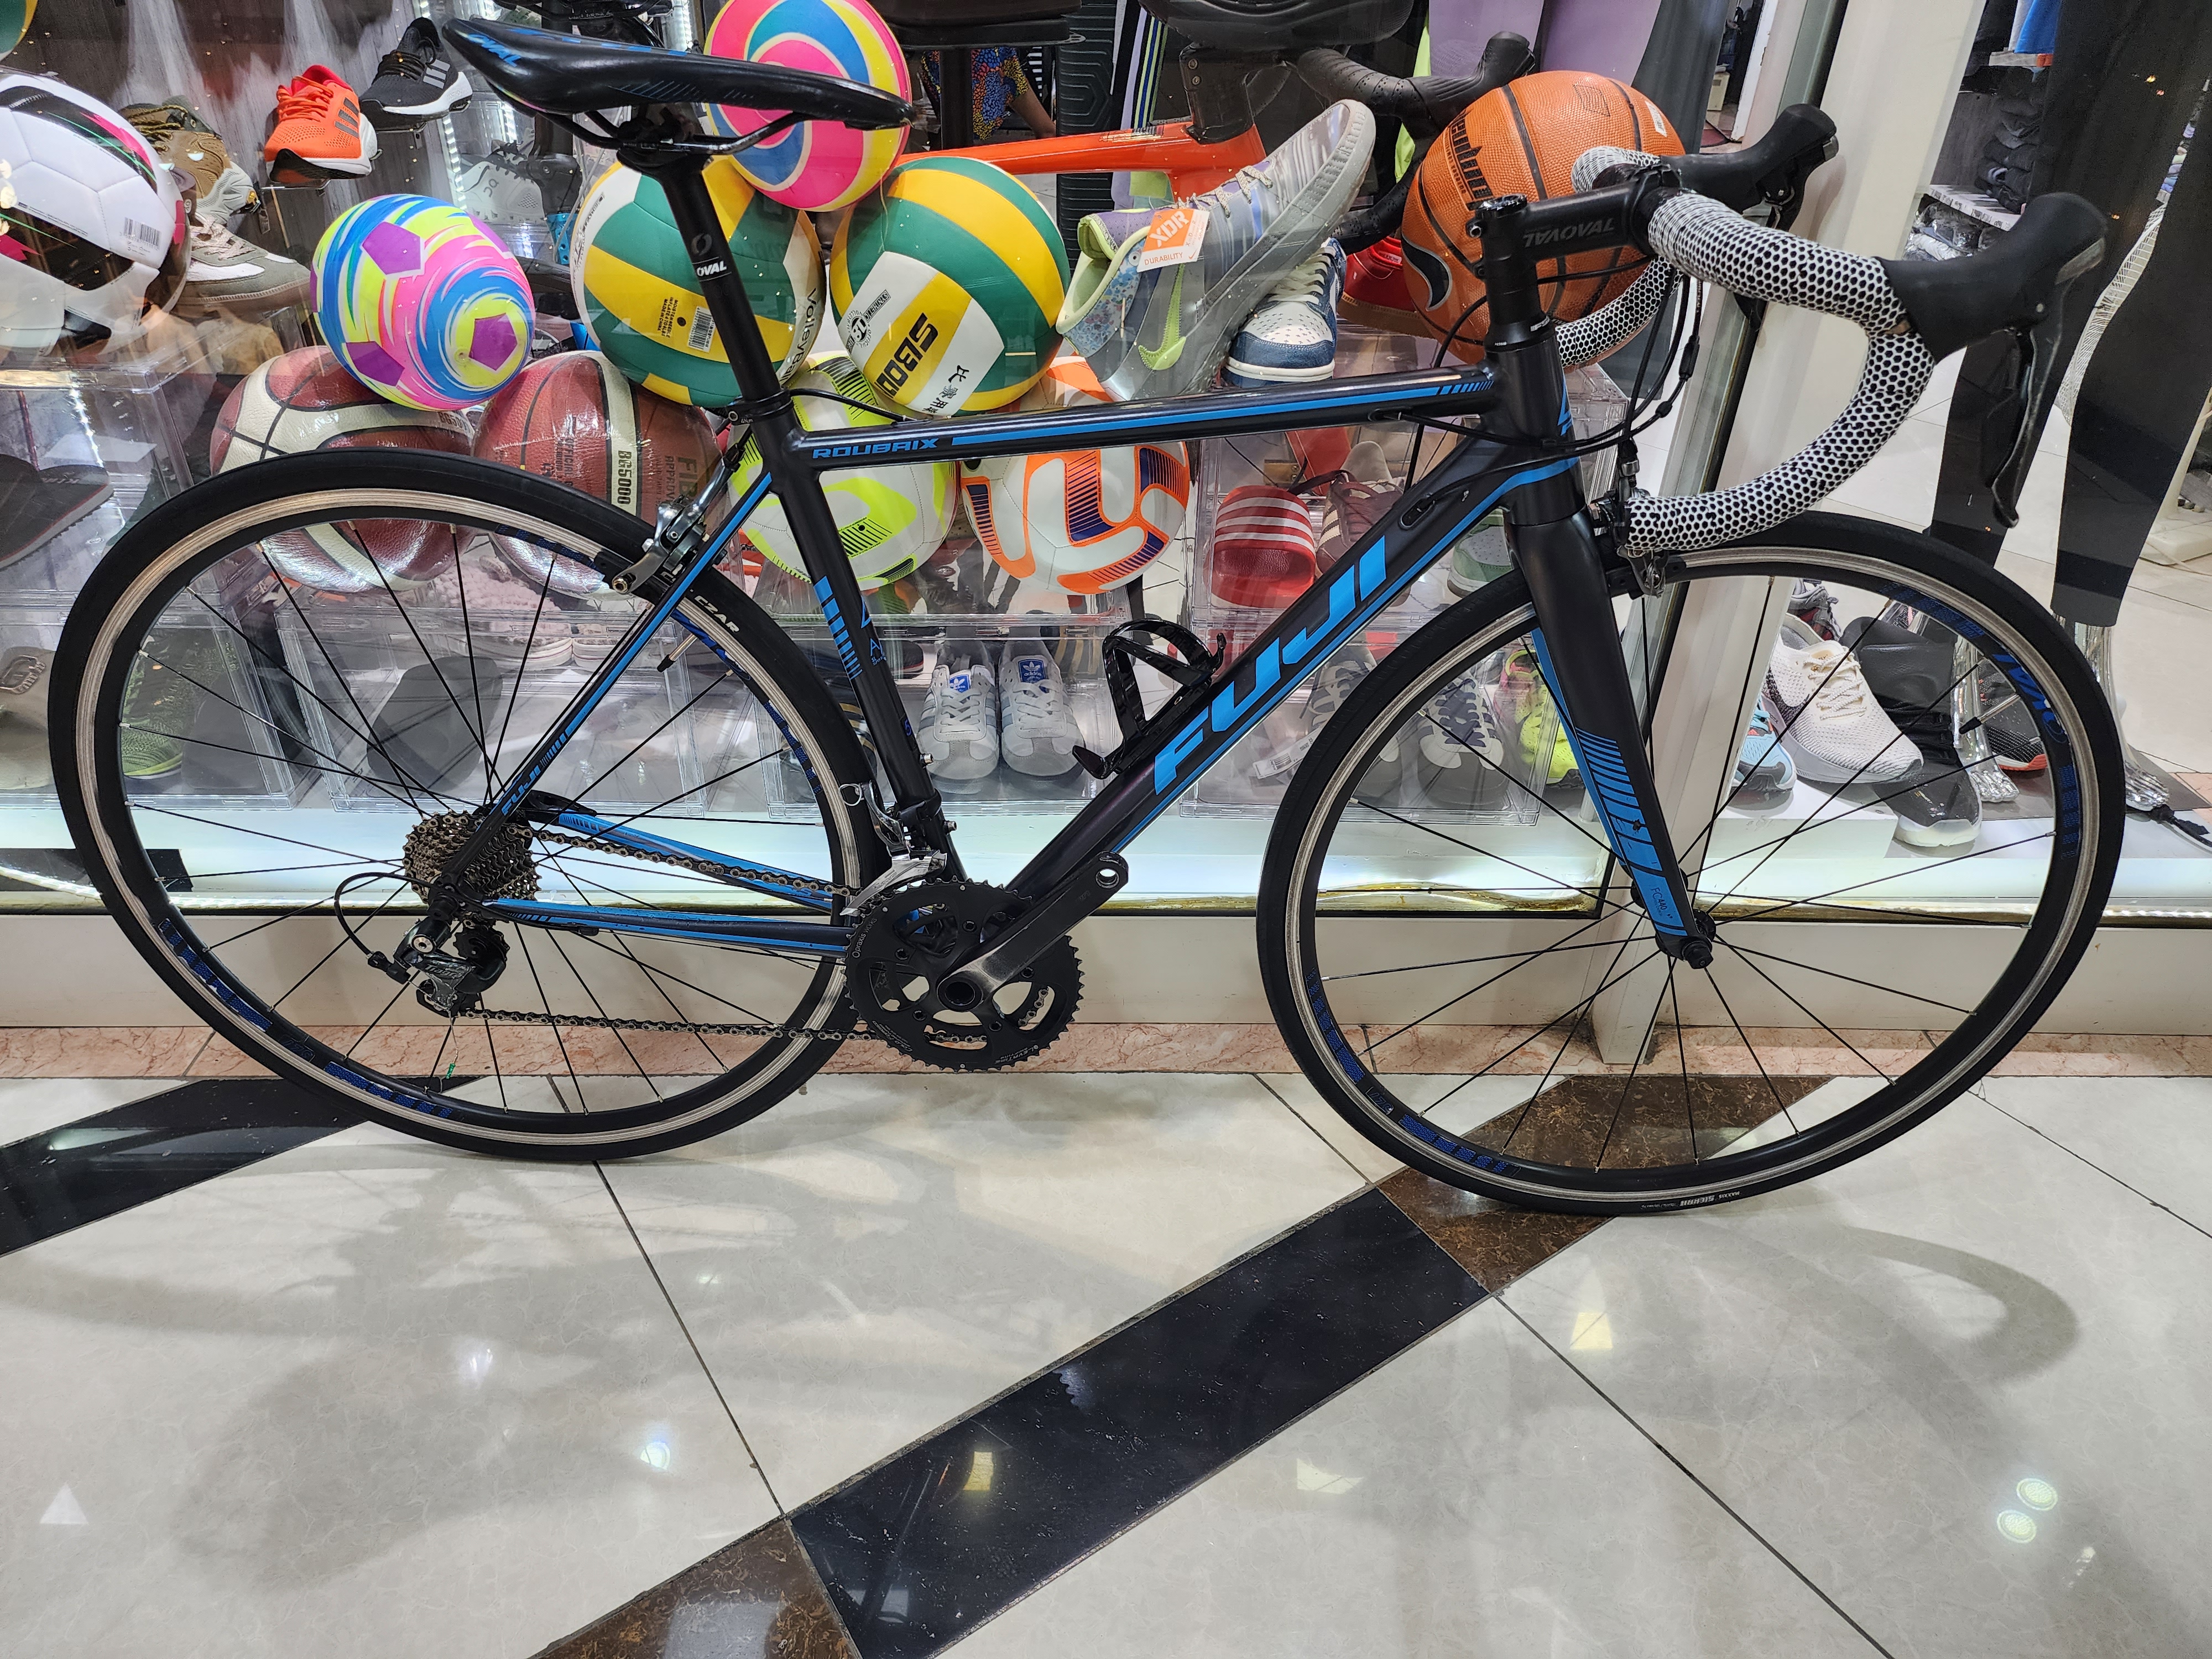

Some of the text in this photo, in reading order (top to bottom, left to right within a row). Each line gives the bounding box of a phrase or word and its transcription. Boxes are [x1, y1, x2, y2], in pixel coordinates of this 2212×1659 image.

[1149, 211, 1190, 248] XDR
[697, 260, 727, 277] OVAL
[1145, 252, 1183, 265] DURABILITY
[812, 438, 940, 459] ROUBAIX
[617, 450, 632, 505] BG5000
[677, 456, 699, 497] FIB
[694, 595, 740, 633] CZAR
[1154, 535, 1387, 795] FUJI
[501, 764, 541, 816] FUJI
[1651, 886, 1668, 910] FC440
[425, 964, 463, 978] Tiagra
[1718, 1191, 1740, 1199] MAXXIS
